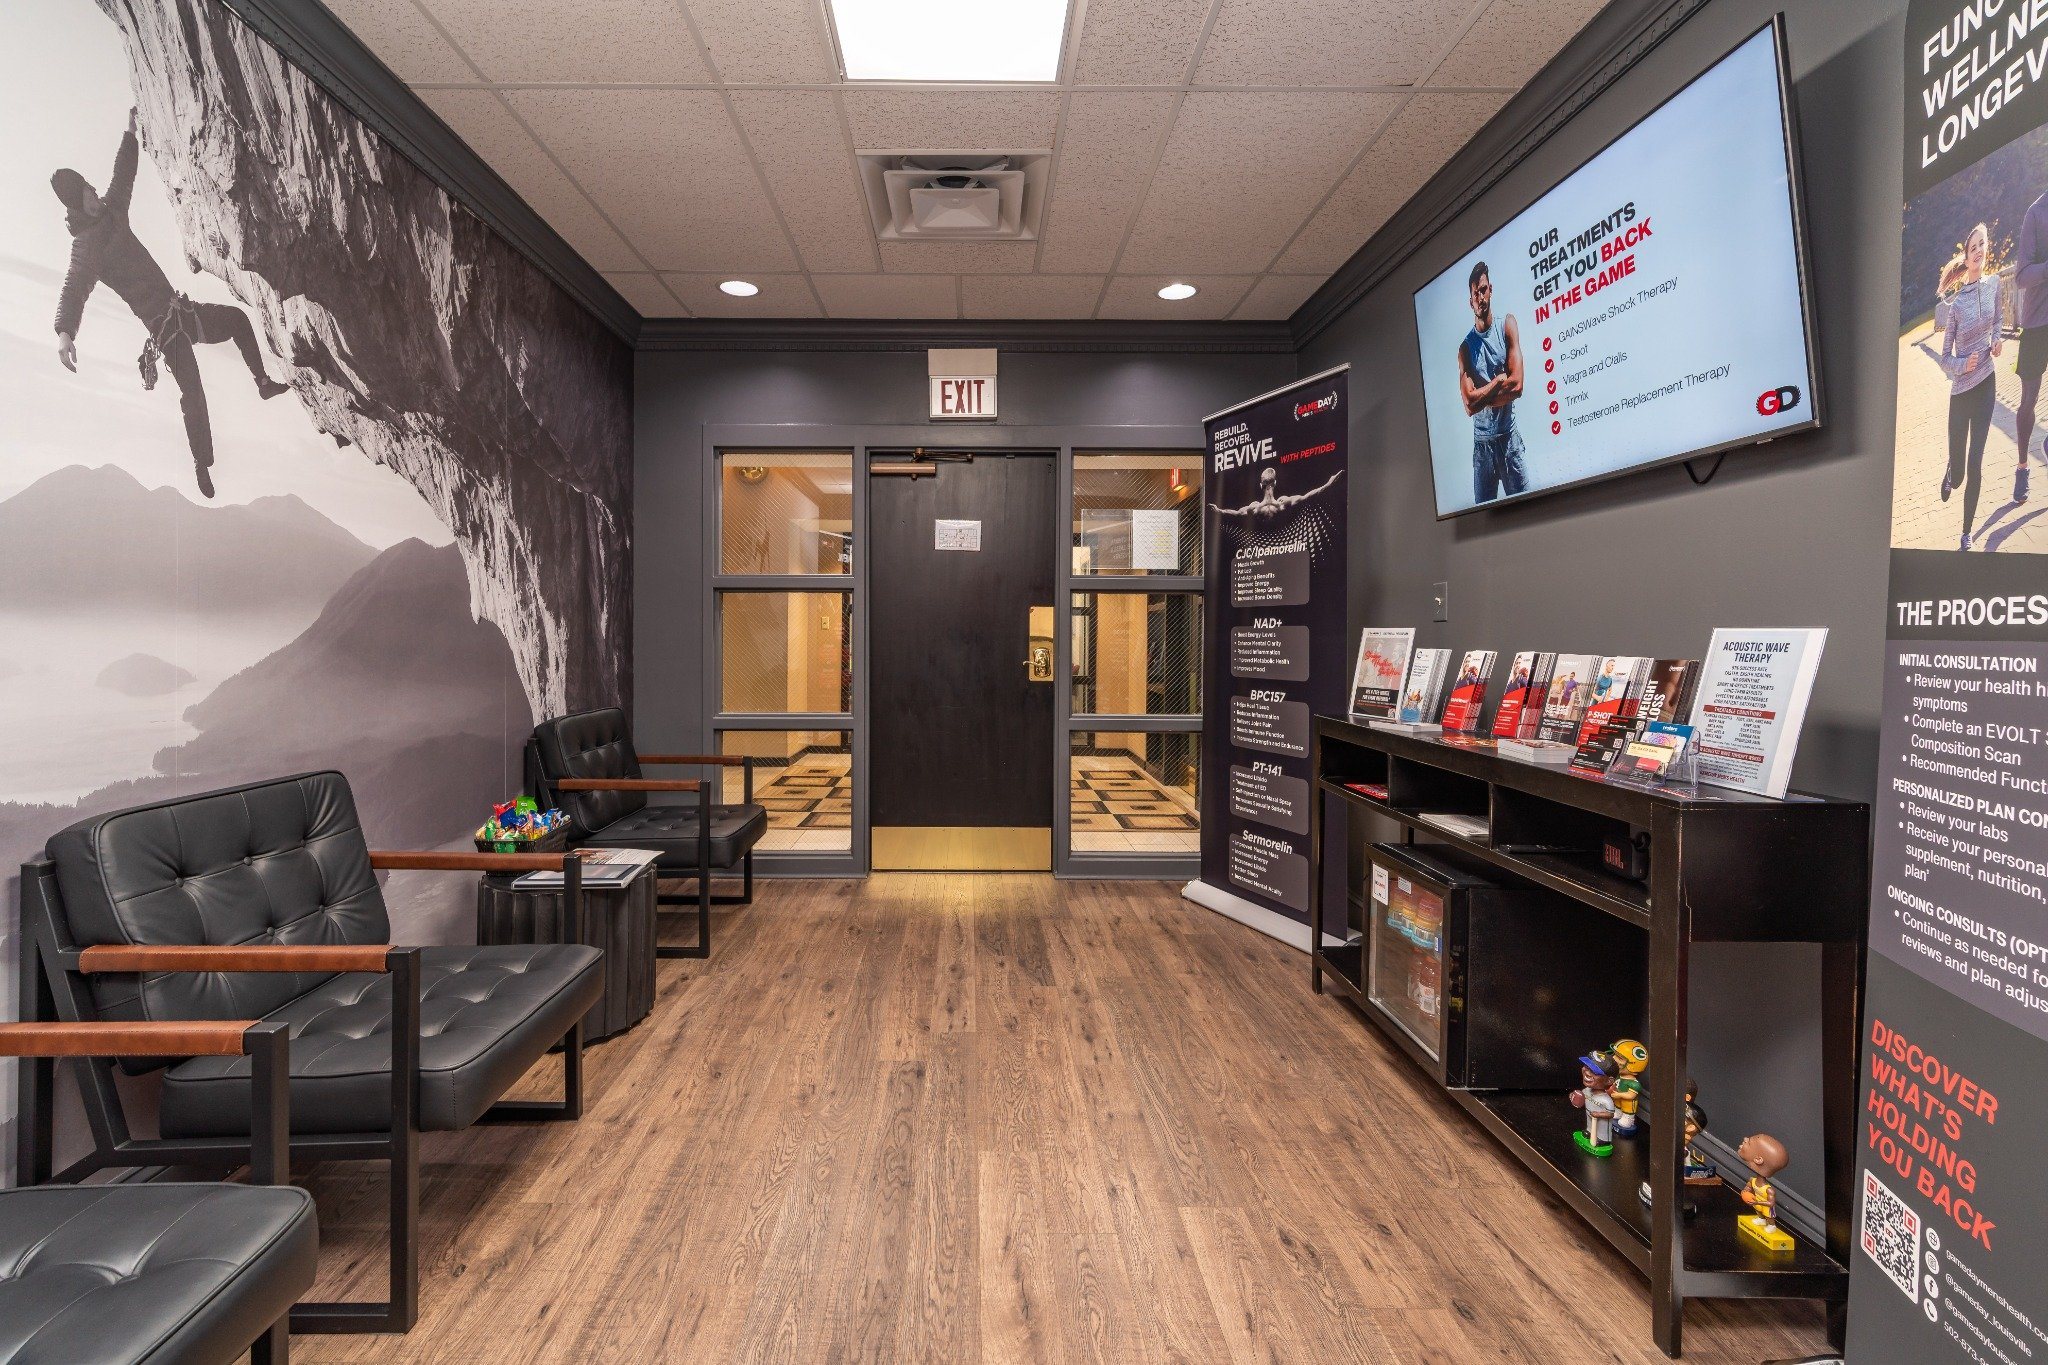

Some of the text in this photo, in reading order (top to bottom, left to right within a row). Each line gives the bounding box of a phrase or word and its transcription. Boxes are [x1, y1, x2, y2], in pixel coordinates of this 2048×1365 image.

[1529, 227, 1559, 258] OUR
[1531, 202, 1636, 280] TREATMENTS
[1534, 217, 1653, 301] GET YOU BACK
[1535, 254, 1635, 324] IN THE GAME
[1608, 297, 1635, 318] Shock
[1637, 276, 1678, 304] Therapy
[1560, 344, 1588, 364] P-Shot
[1563, 367, 1587, 385] Viagra
[1588, 361, 1603, 376] and
[941, 380, 984, 414] EXIT
[1297, 395, 1333, 415] GAMEDAY
[1565, 391, 1589, 407] Trimix
[1568, 363, 1731, 428] Testosterone Replacement Therapy
[1756, 385, 1801, 416] GD
[1215, 423, 1248, 440] REBUILD.
[1215, 433, 1252, 452] RECOVER.
[1215, 438, 1276, 473] REVIVE.
[1280, 442, 1336, 464] WITH PEPTIDES
[1254, 618, 1282, 629] NAD+
[1897, 595, 2048, 625] THE PROCES
[1723, 642, 1790, 652] ACOUSTIC WAVE
[1735, 653, 1772, 663] THERAPY
[1900, 654, 2037, 672] INITIAL CONSULTATION
[1250, 689, 1286, 703] BPC157
[1636, 679, 1659, 718] WEIGHT
[1914, 674, 1951, 689] Review
[1954, 679, 1981, 693] your
[1985, 678, 2031, 695] health
[1588, 710, 1612, 720] P-SHOT
[1648, 694, 1666, 721] LOSS
[1913, 696, 1968, 712] symptoms
[1912, 714, 1963, 733] Complete
[1966, 724, 1982, 736] an
[1986, 724, 2041, 744] EVOLT
[1912, 734, 2021, 765] Composition Scan
[1252, 762, 1282, 776] PT-141
[1910, 754, 2048, 794] Recommended Funct
[1894, 778, 1974, 810] PERSONALIZED
[1977, 799, 2015, 821] PLAN
[1908, 802, 2008, 842] Review your labs
[1242, 830, 1292, 854] Sermorelin
[1907, 822, 1949, 846] Receive
[1952, 838, 1980, 856] your
[1906, 844, 2046, 904] supplement, nutrition,
[1888, 885, 1934, 916] ONGOING
[1936, 907, 2006, 947] CONSULTS
[1903, 911, 1952, 945] Continue
[1955, 938, 1969, 954] as
[1973, 945, 2027, 979] needed
[1902, 933, 1942, 963] reviews
[1945, 955, 1968, 975] and
[1972, 967, 2001, 991] plan
[1871, 1019, 1999, 1125] DISCOVER
[1872, 1053, 1962, 1141] WHAT'S
[1868, 1089, 1976, 1193] HOLDING
[1868, 1122, 1996, 1252] YOU BACK
[1947, 1250, 2048, 1344] gamedaymenshealth.co
[1946, 1273, 2032, 1357] @gameday_louisville
